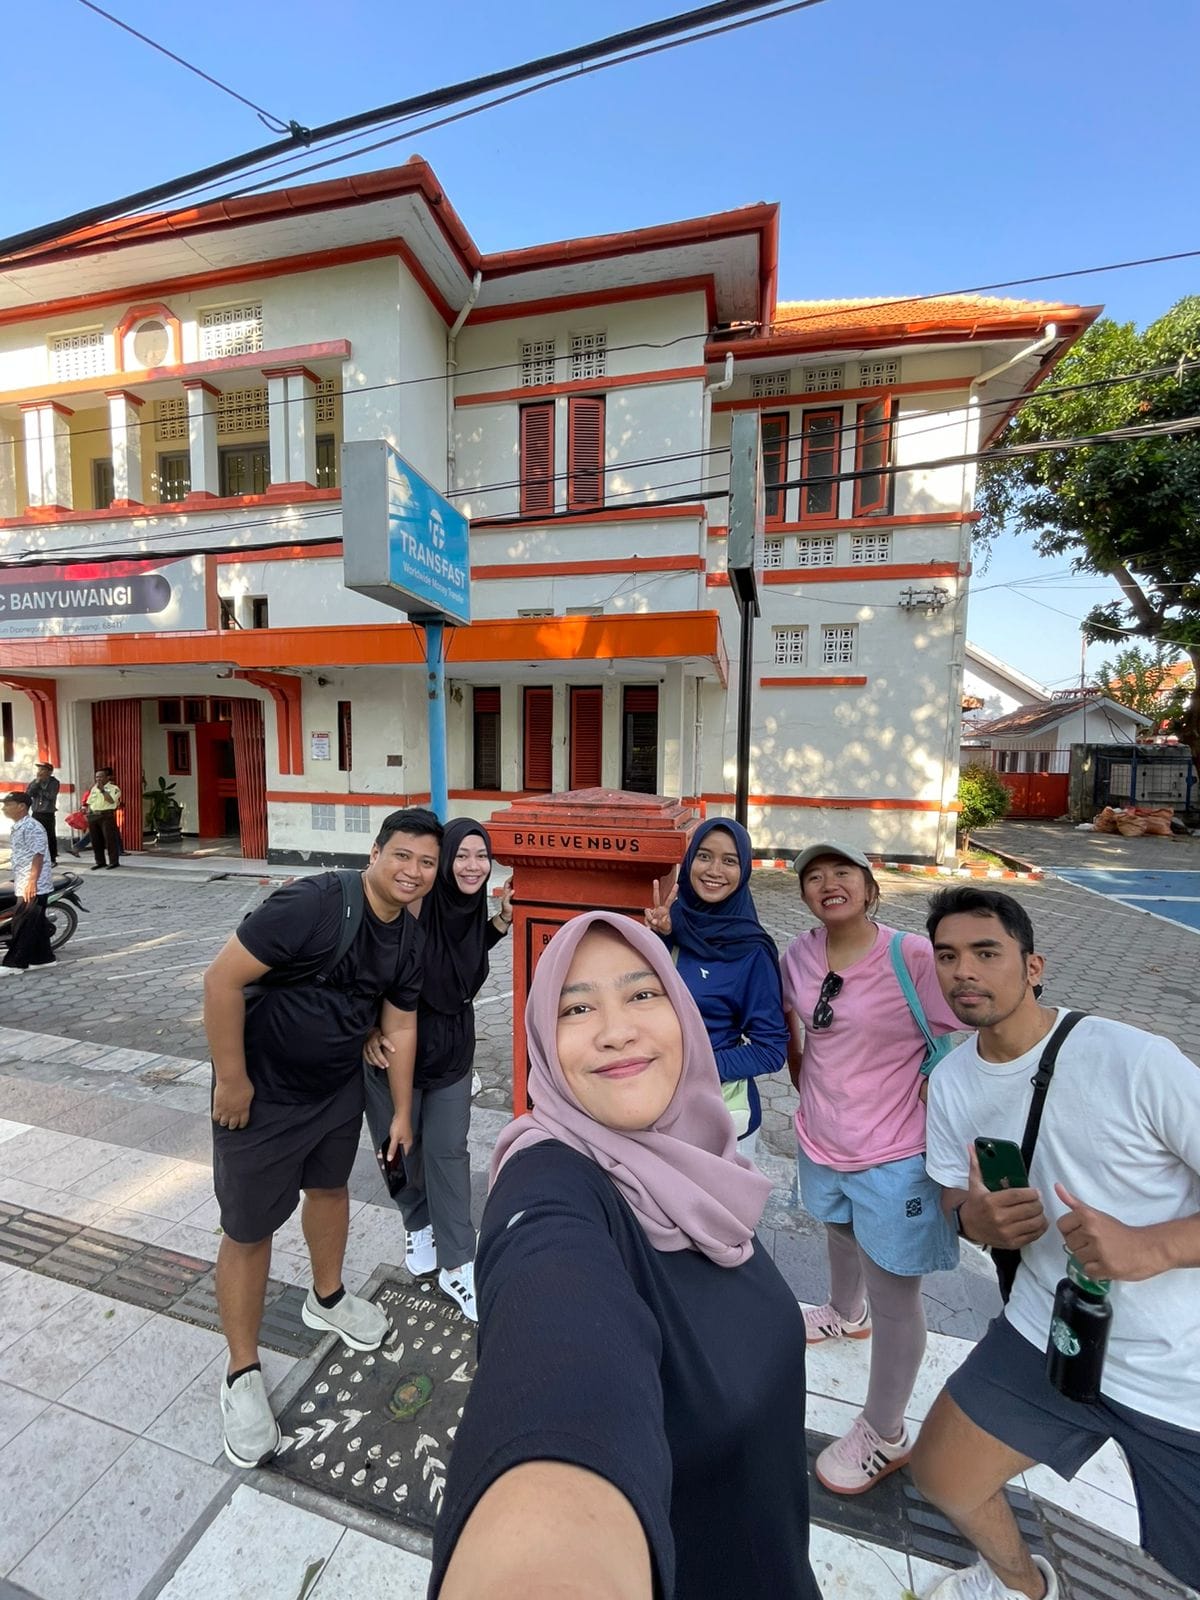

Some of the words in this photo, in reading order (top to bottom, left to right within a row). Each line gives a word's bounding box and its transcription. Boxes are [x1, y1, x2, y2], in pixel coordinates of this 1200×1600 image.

[400, 530, 465, 589] TRANSFAST
[10, 586, 132, 611] BANYUWANGI
[514, 833, 640, 852] BRIEVENBUS
